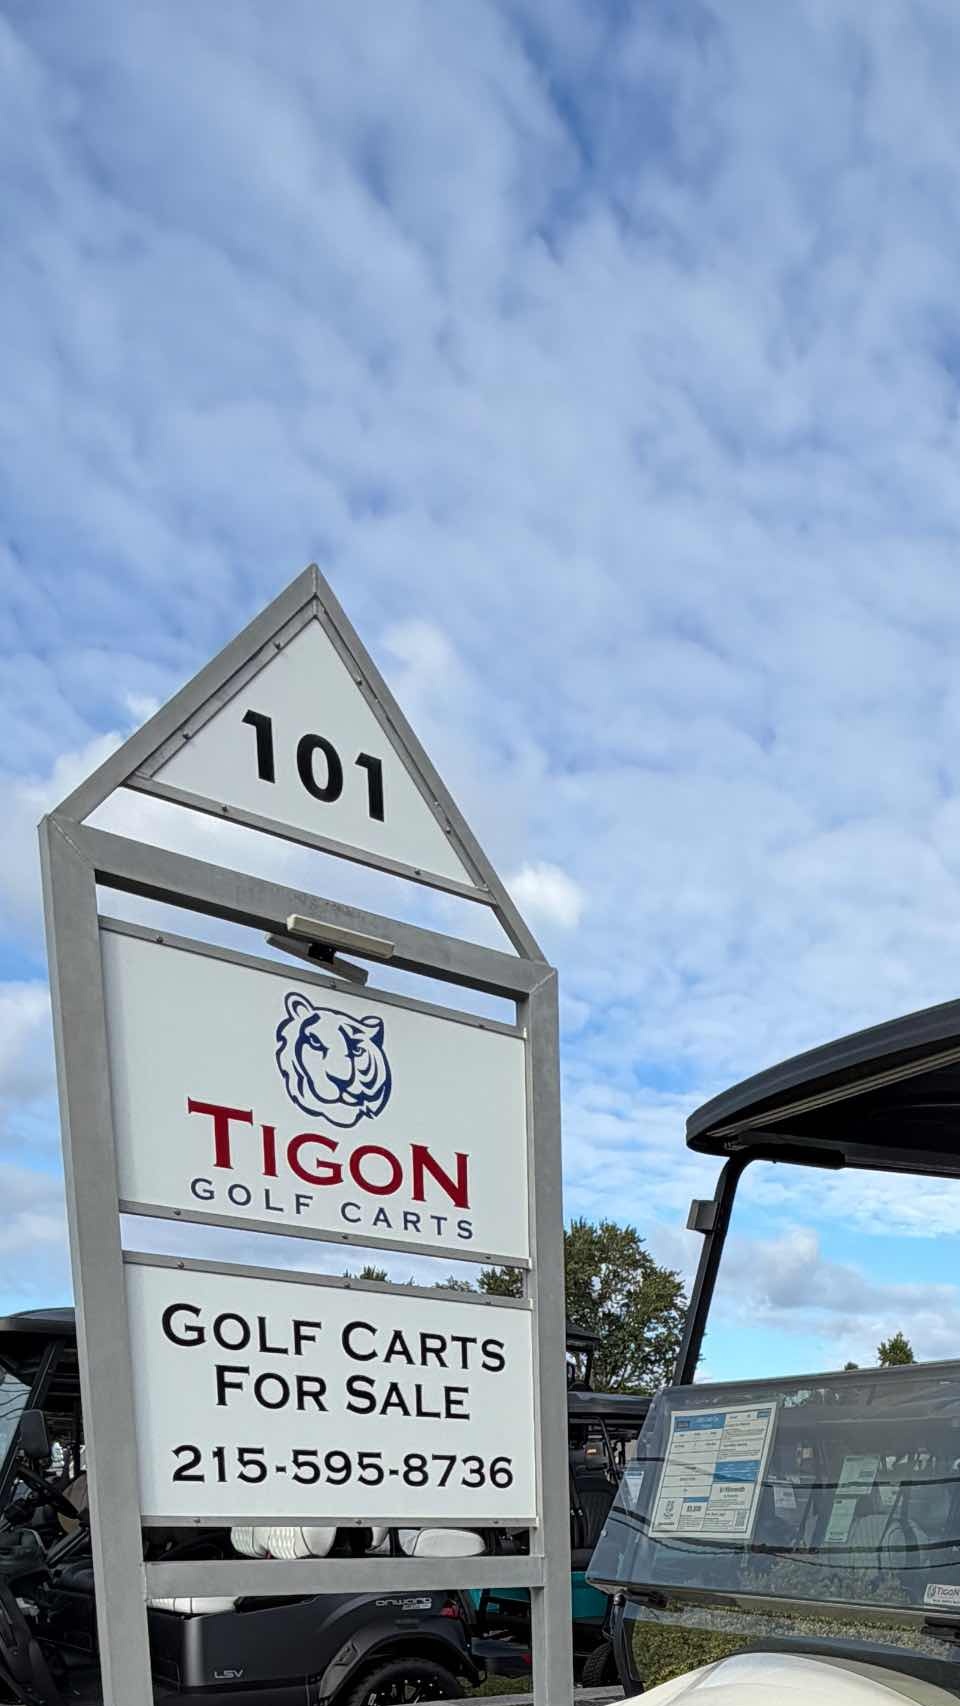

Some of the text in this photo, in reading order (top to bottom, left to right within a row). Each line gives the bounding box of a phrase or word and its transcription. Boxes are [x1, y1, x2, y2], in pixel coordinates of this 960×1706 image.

[243, 710, 384, 822] 101
[187, 1096, 470, 1210] TIGON
[190, 1178, 473, 1240] GOLF CARTS
[162, 1303, 506, 1373] GOLF CARTS
[215, 1364, 471, 1420] FOR SALE
[172, 1445, 514, 1489] 215-595-8736
[214, 1669, 244, 1679] LSV
